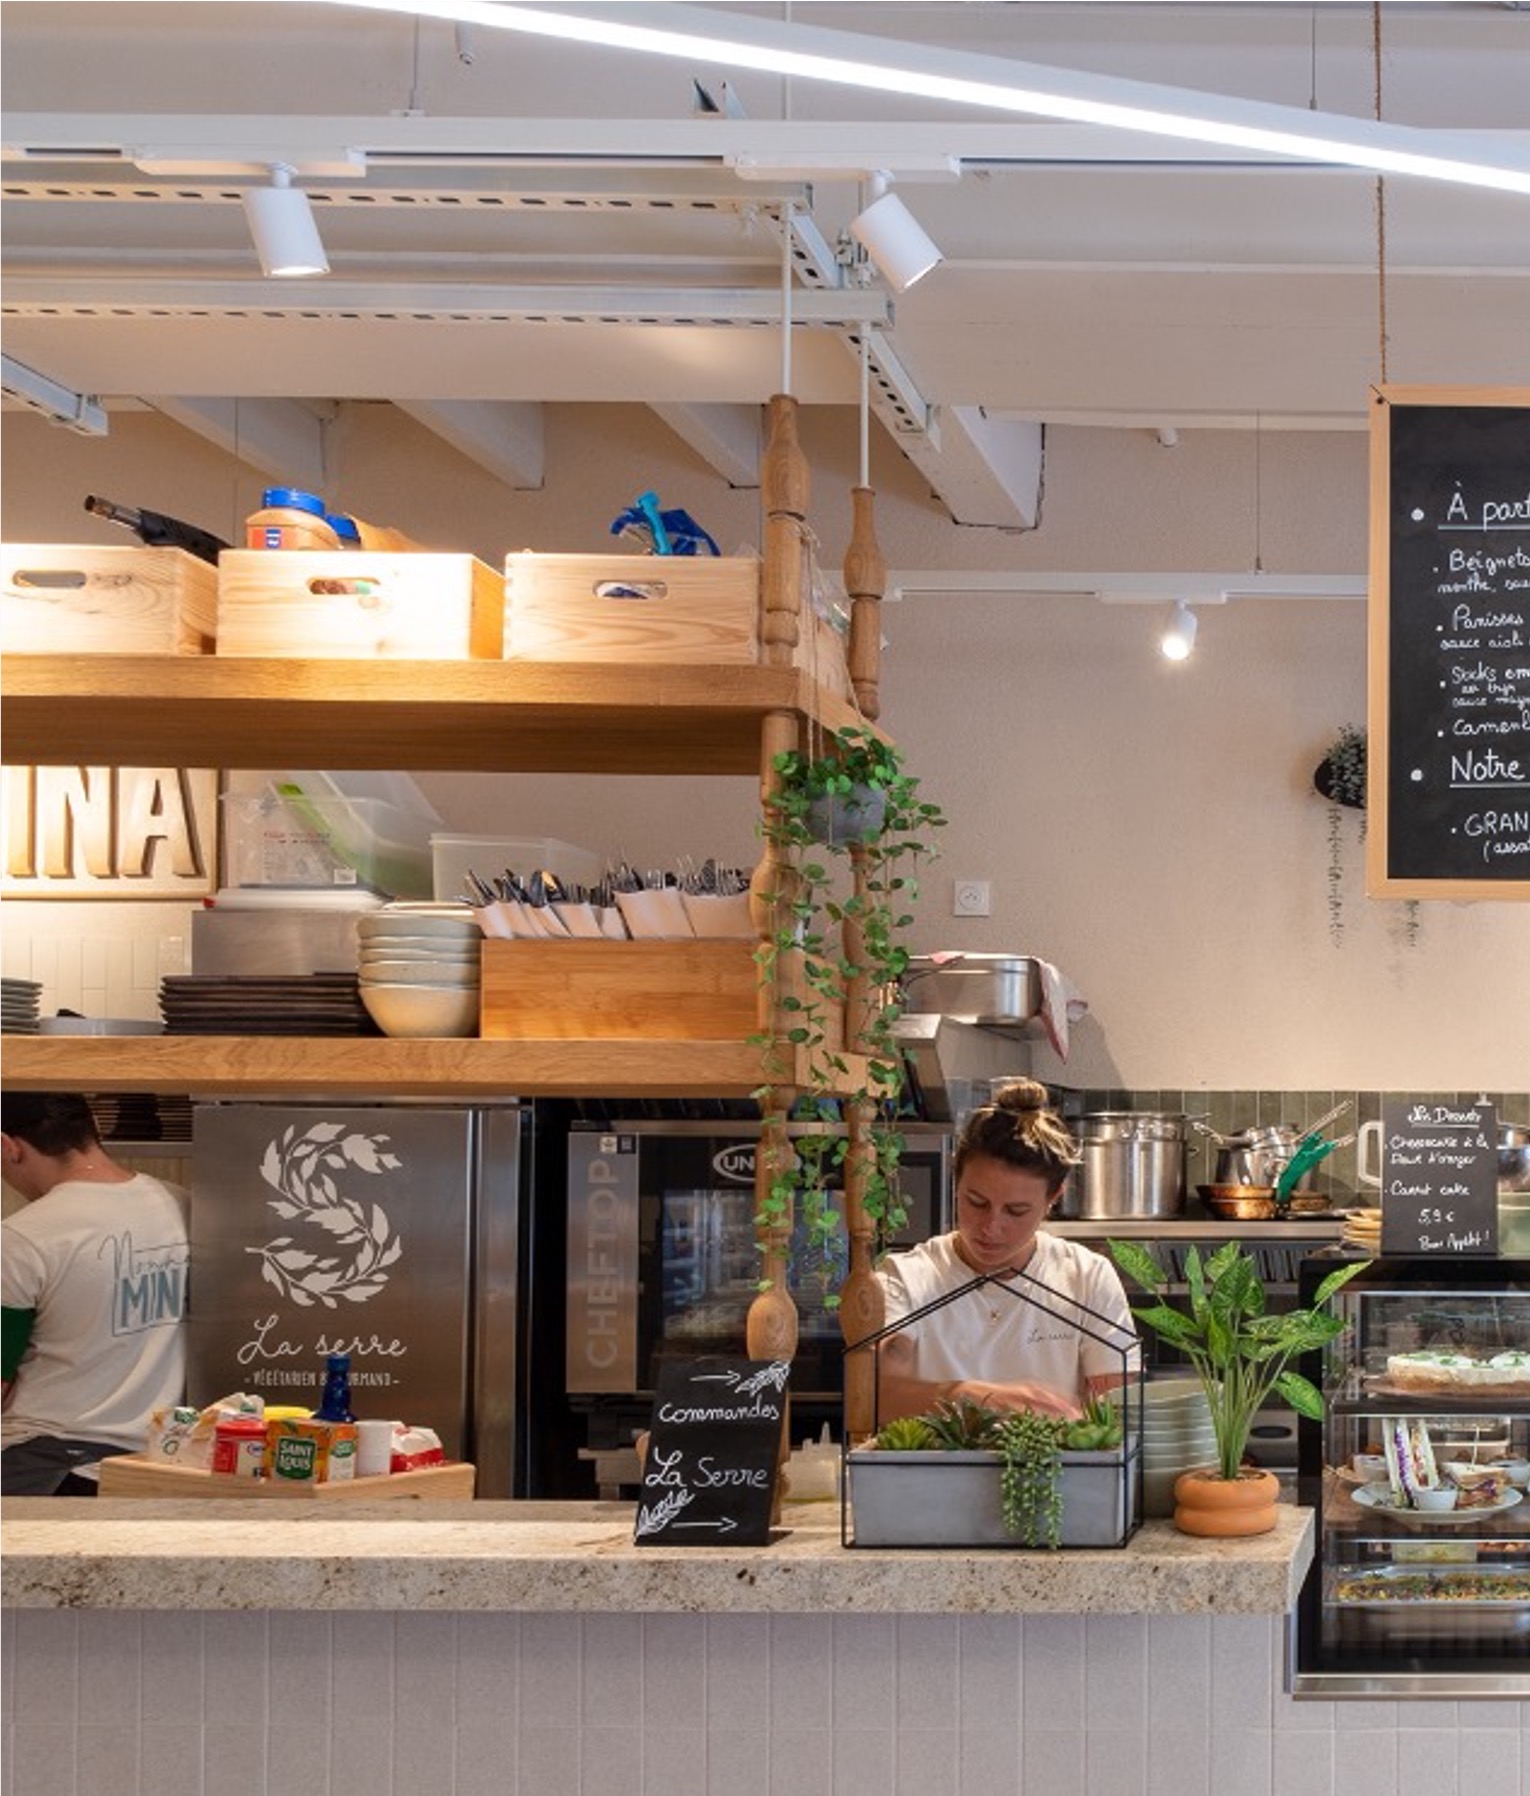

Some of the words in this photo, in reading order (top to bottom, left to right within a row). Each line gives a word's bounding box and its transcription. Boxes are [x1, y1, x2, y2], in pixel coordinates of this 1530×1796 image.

[1447, 481, 1469, 521] À
[1453, 604, 1524, 632] Panisses
[1440, 637, 1481, 651] sauce
[1450, 748, 1526, 781] Notre
[1439, 1182, 1471, 1196] cake
[586, 1157, 620, 1369] CHEFTOP
[237, 1313, 304, 1365] La
[315, 1333, 408, 1356] serre
[659, 1393, 780, 1424] Commandes
[279, 1439, 314, 1457] SAINT
[279, 1453, 313, 1471] LOUIS
[645, 1446, 688, 1488] La
[693, 1456, 770, 1489] Serre
